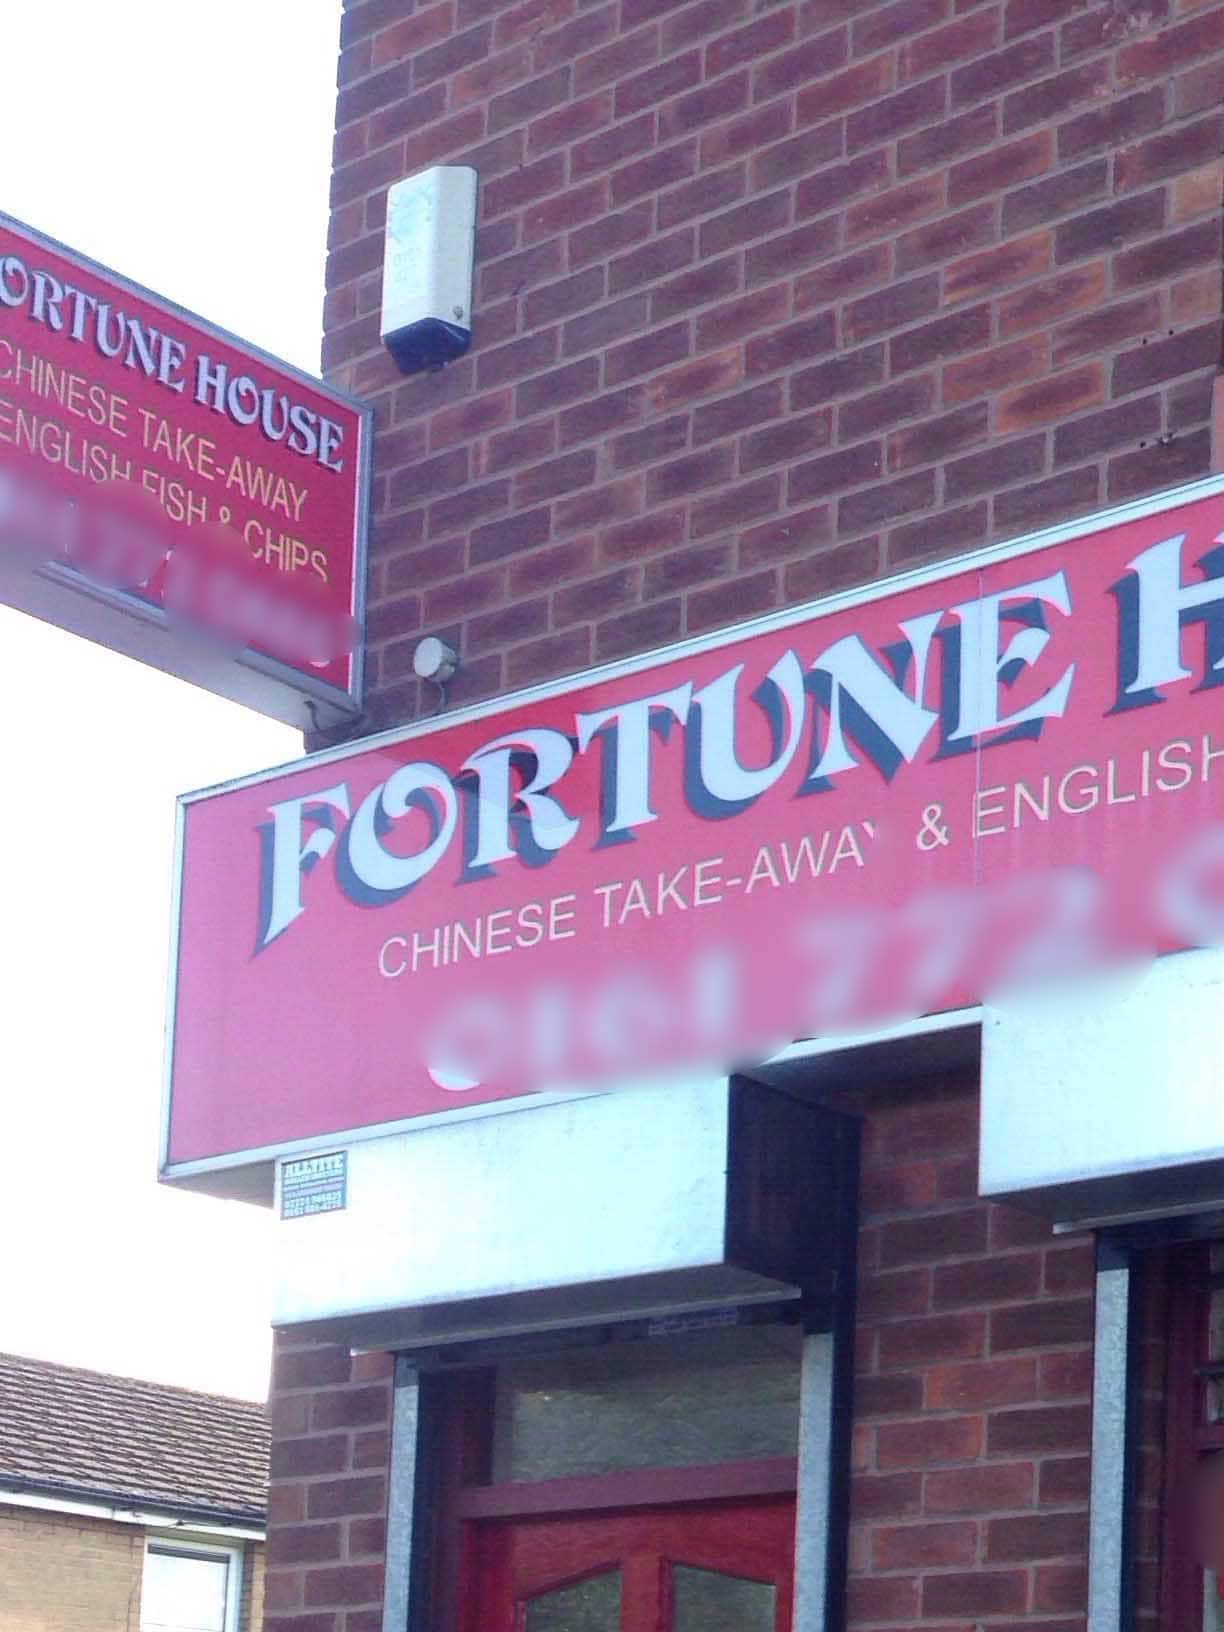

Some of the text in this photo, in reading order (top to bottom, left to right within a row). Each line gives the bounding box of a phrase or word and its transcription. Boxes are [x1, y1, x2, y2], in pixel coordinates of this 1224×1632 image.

[138, 407, 309, 523] TAKE-AWAY
[193, 354, 346, 474] HOUSE
[252, 570, 1075, 959] FORTUNE
[378, 895, 577, 979] CHINESE
[594, 822, 878, 928] TAKE-AWA
[915, 802, 952, 852] &
